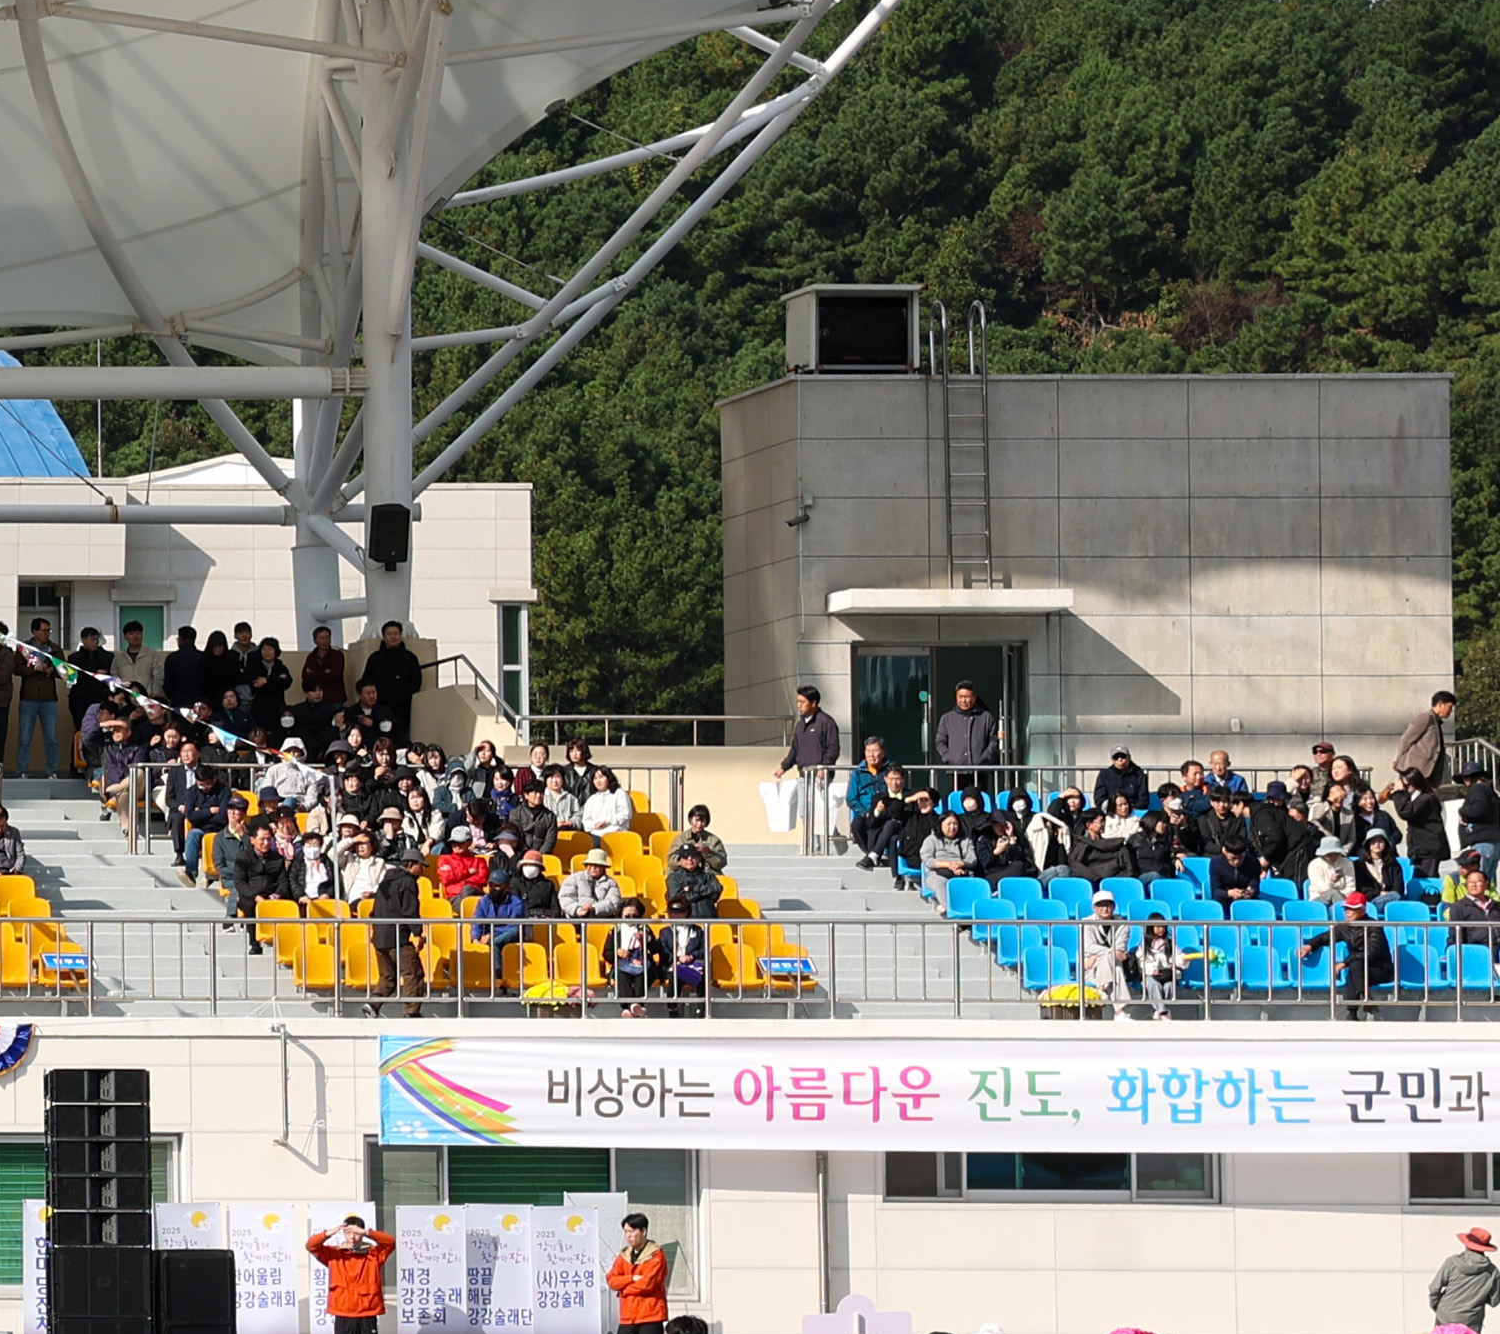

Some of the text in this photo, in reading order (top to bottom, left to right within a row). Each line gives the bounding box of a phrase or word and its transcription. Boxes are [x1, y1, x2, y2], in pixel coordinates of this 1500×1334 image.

[547, 1064, 1491, 1127] 비상하는 아름다운 진도, 화합하는 군민과
[400, 1267, 431, 1286] 재경
[467, 1267, 493, 1286] 땅끝
[536, 1269, 595, 1289] (사)우수영
[401, 1287, 462, 1306] 강강술래
[467, 1287, 493, 1306] 해남
[537, 1290, 585, 1309] 강강술래
[401, 1308, 447, 1326] 보존회
[468, 1308, 533, 1327] 강강술래단
